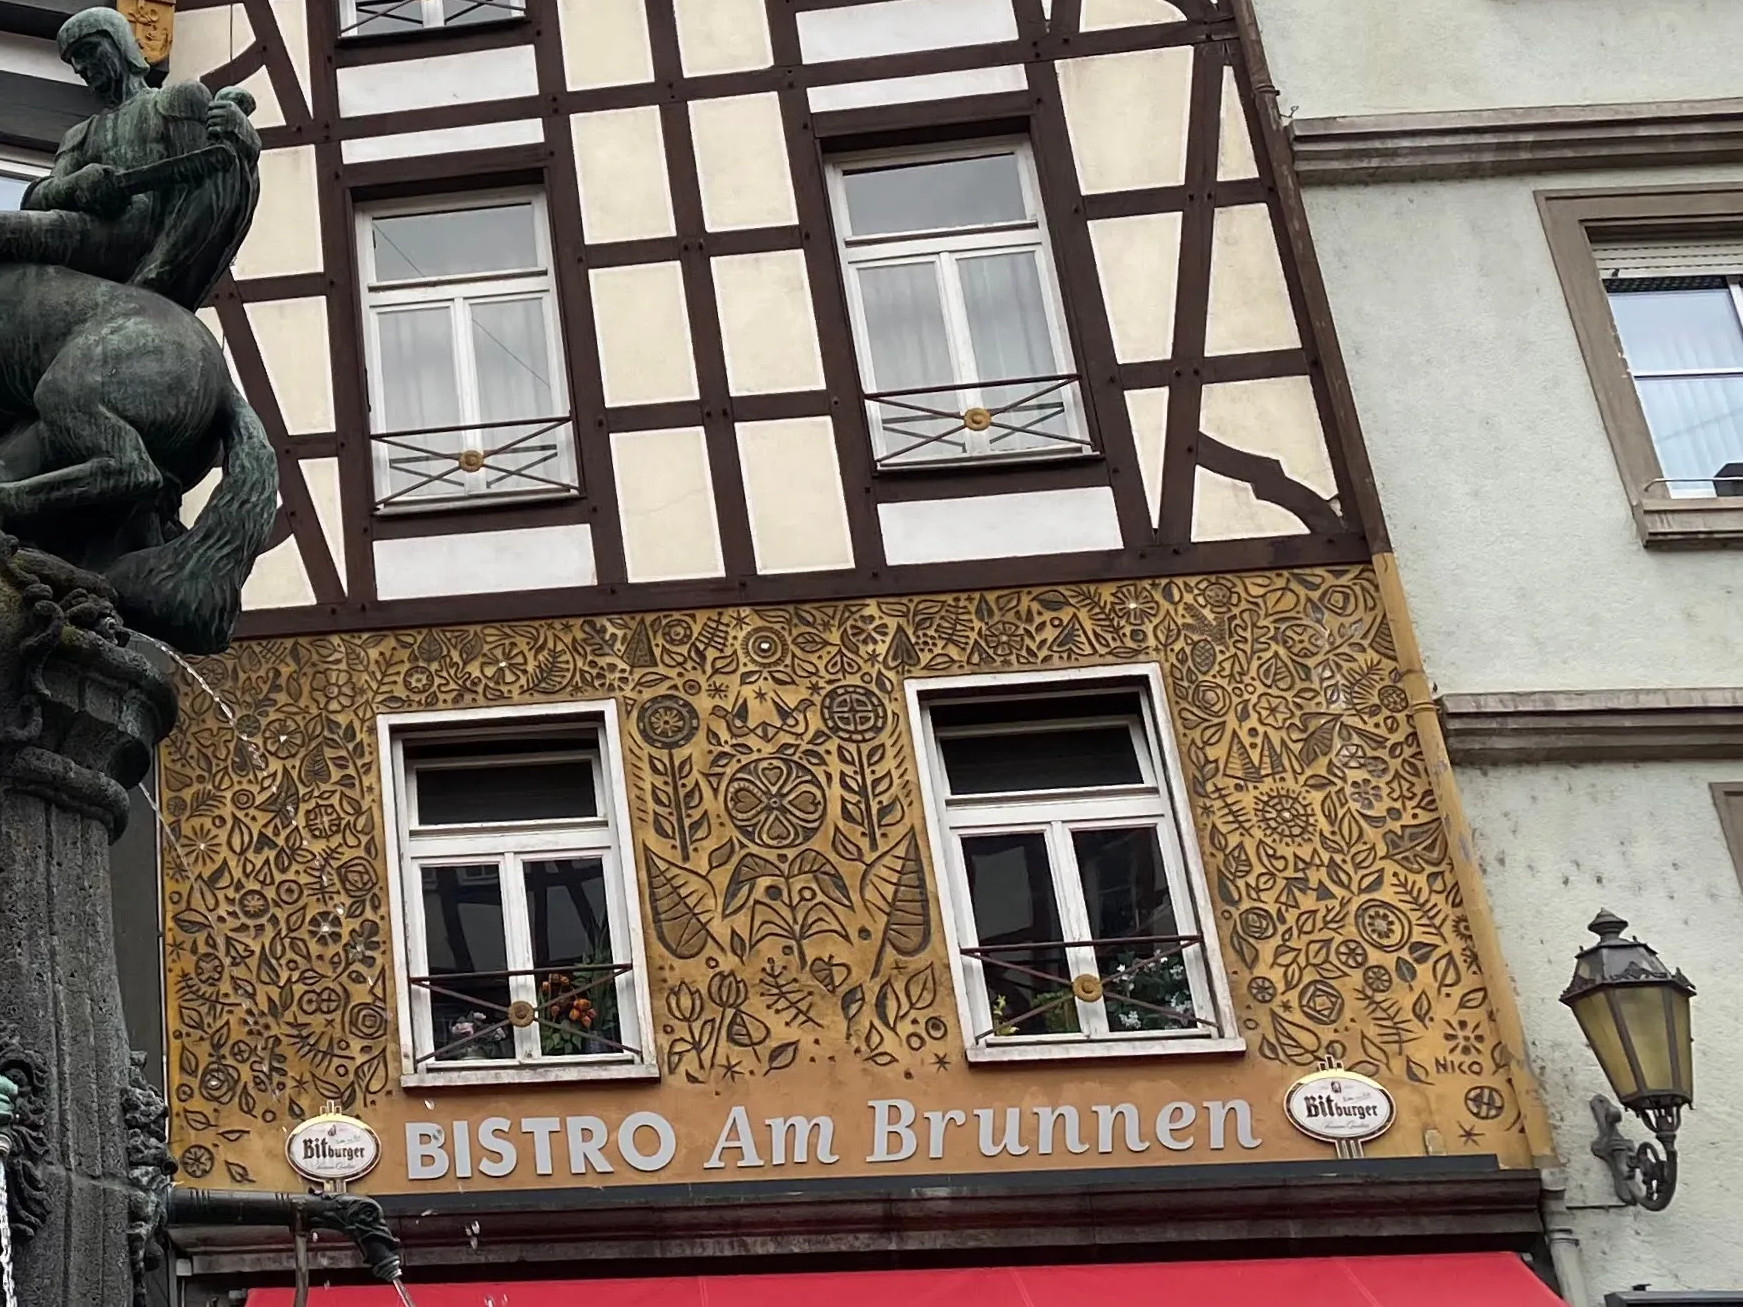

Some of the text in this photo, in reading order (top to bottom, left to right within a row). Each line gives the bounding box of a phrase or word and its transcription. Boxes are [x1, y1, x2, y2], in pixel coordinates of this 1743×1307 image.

[1434, 1055, 1484, 1076] NICO
[1303, 1094, 1378, 1120] Bitburger
[302, 1137, 366, 1161] Bitburger
[404, 1097, 1262, 1181] BISTRO Am Brunnen
